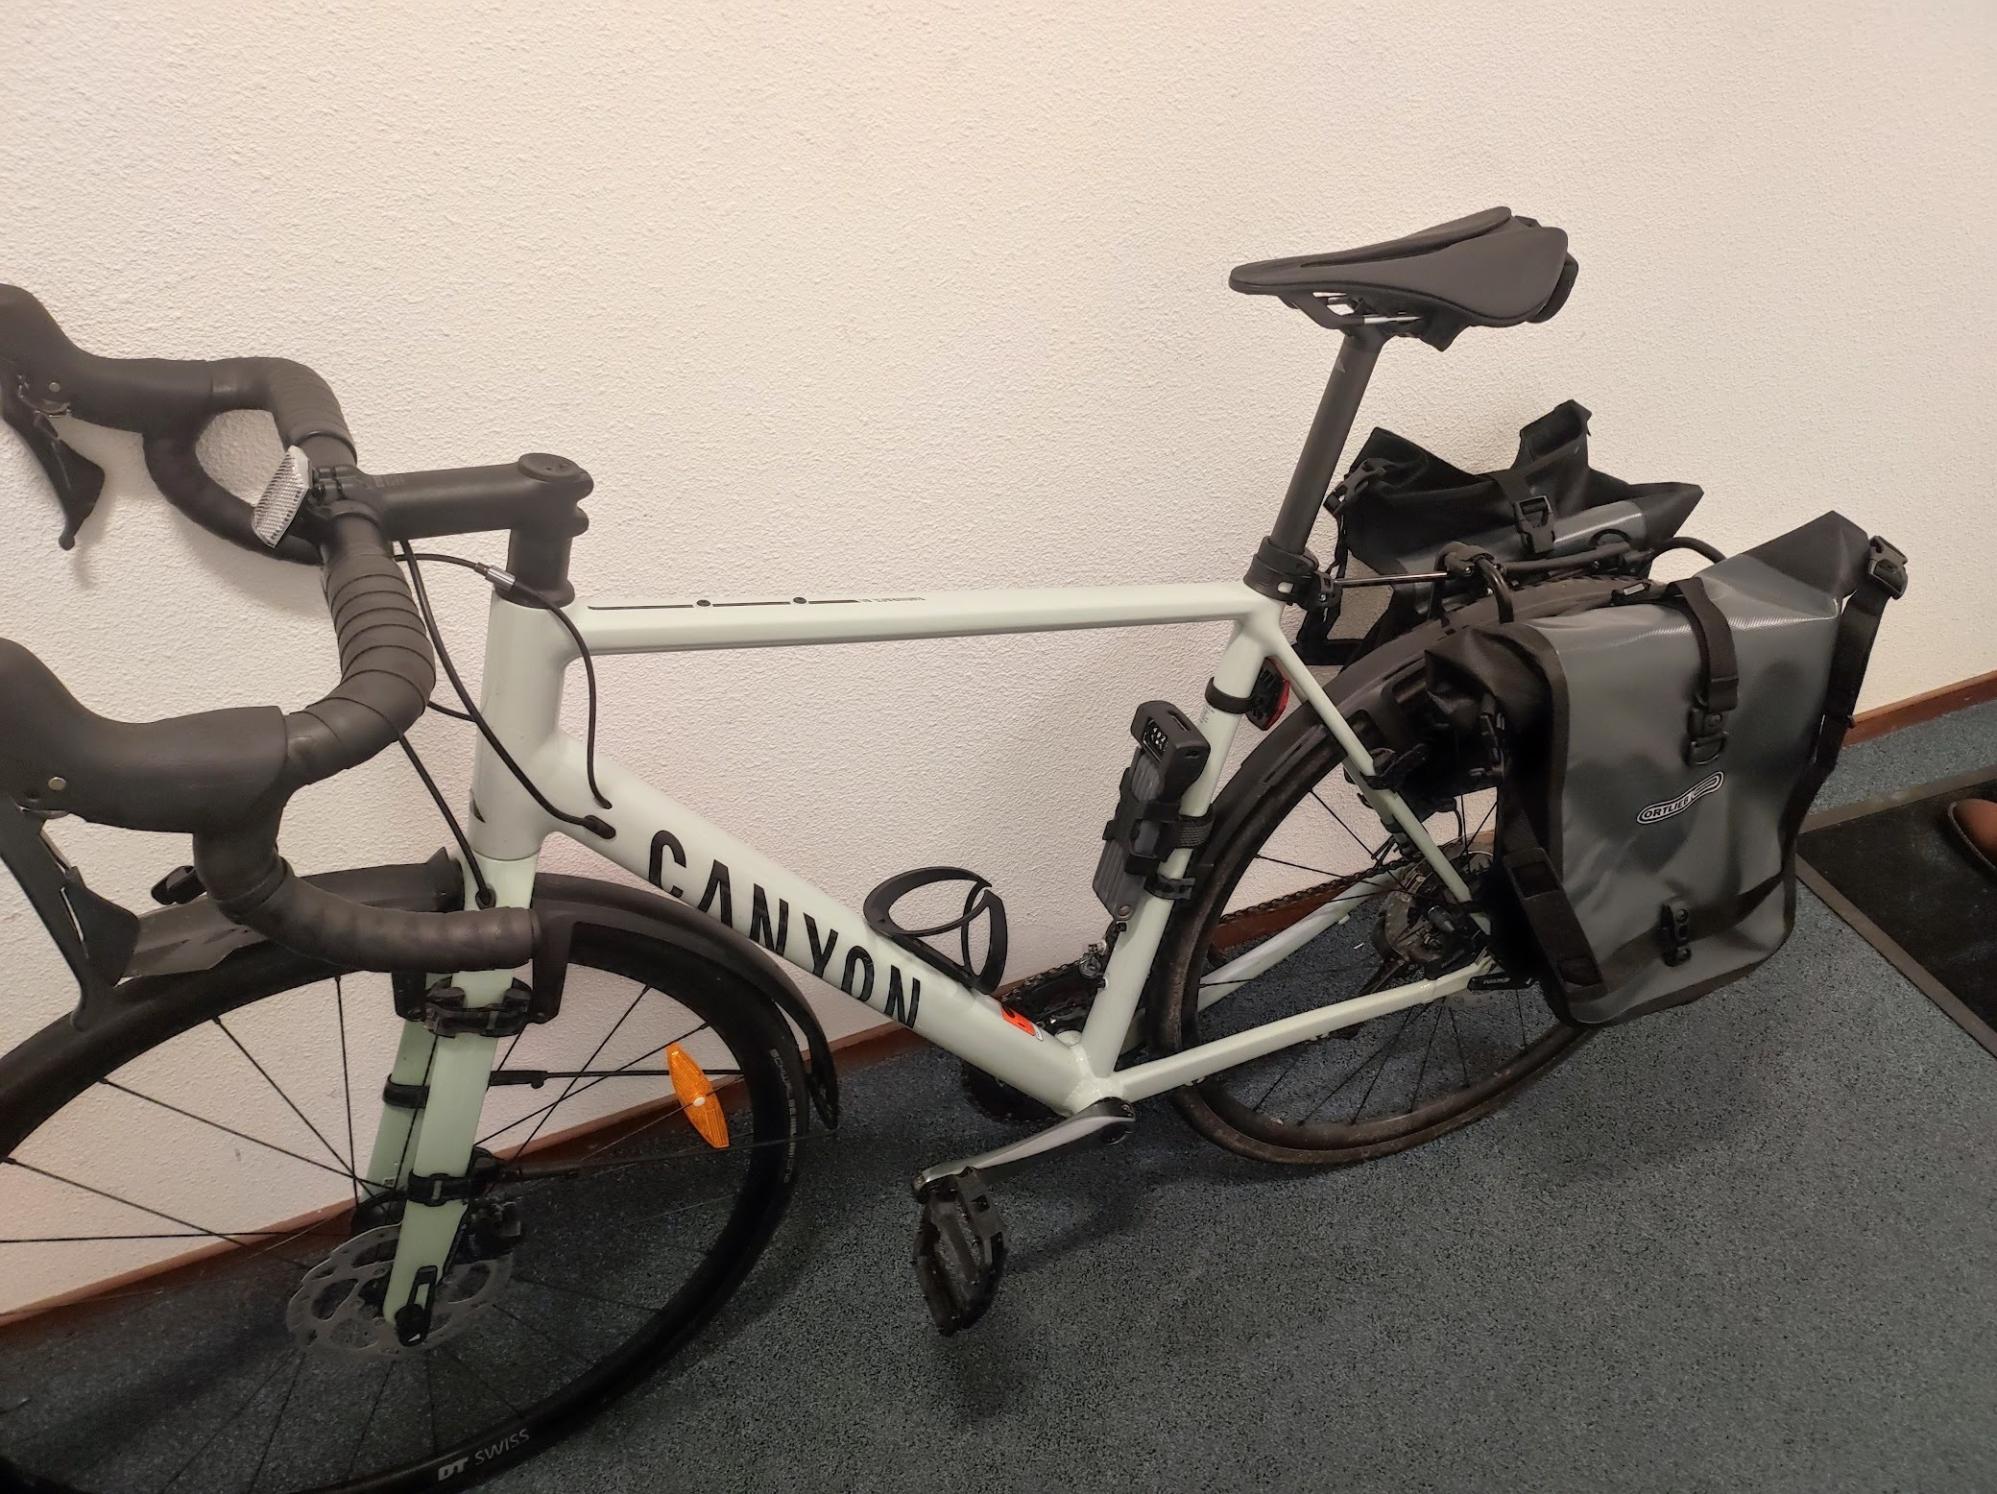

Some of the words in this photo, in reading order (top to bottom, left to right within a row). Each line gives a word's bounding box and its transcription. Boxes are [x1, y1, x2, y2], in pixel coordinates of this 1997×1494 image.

[648, 829, 921, 1029] CANYON
[437, 1456, 470, 1482] DT
[474, 1428, 531, 1466] SWISS
